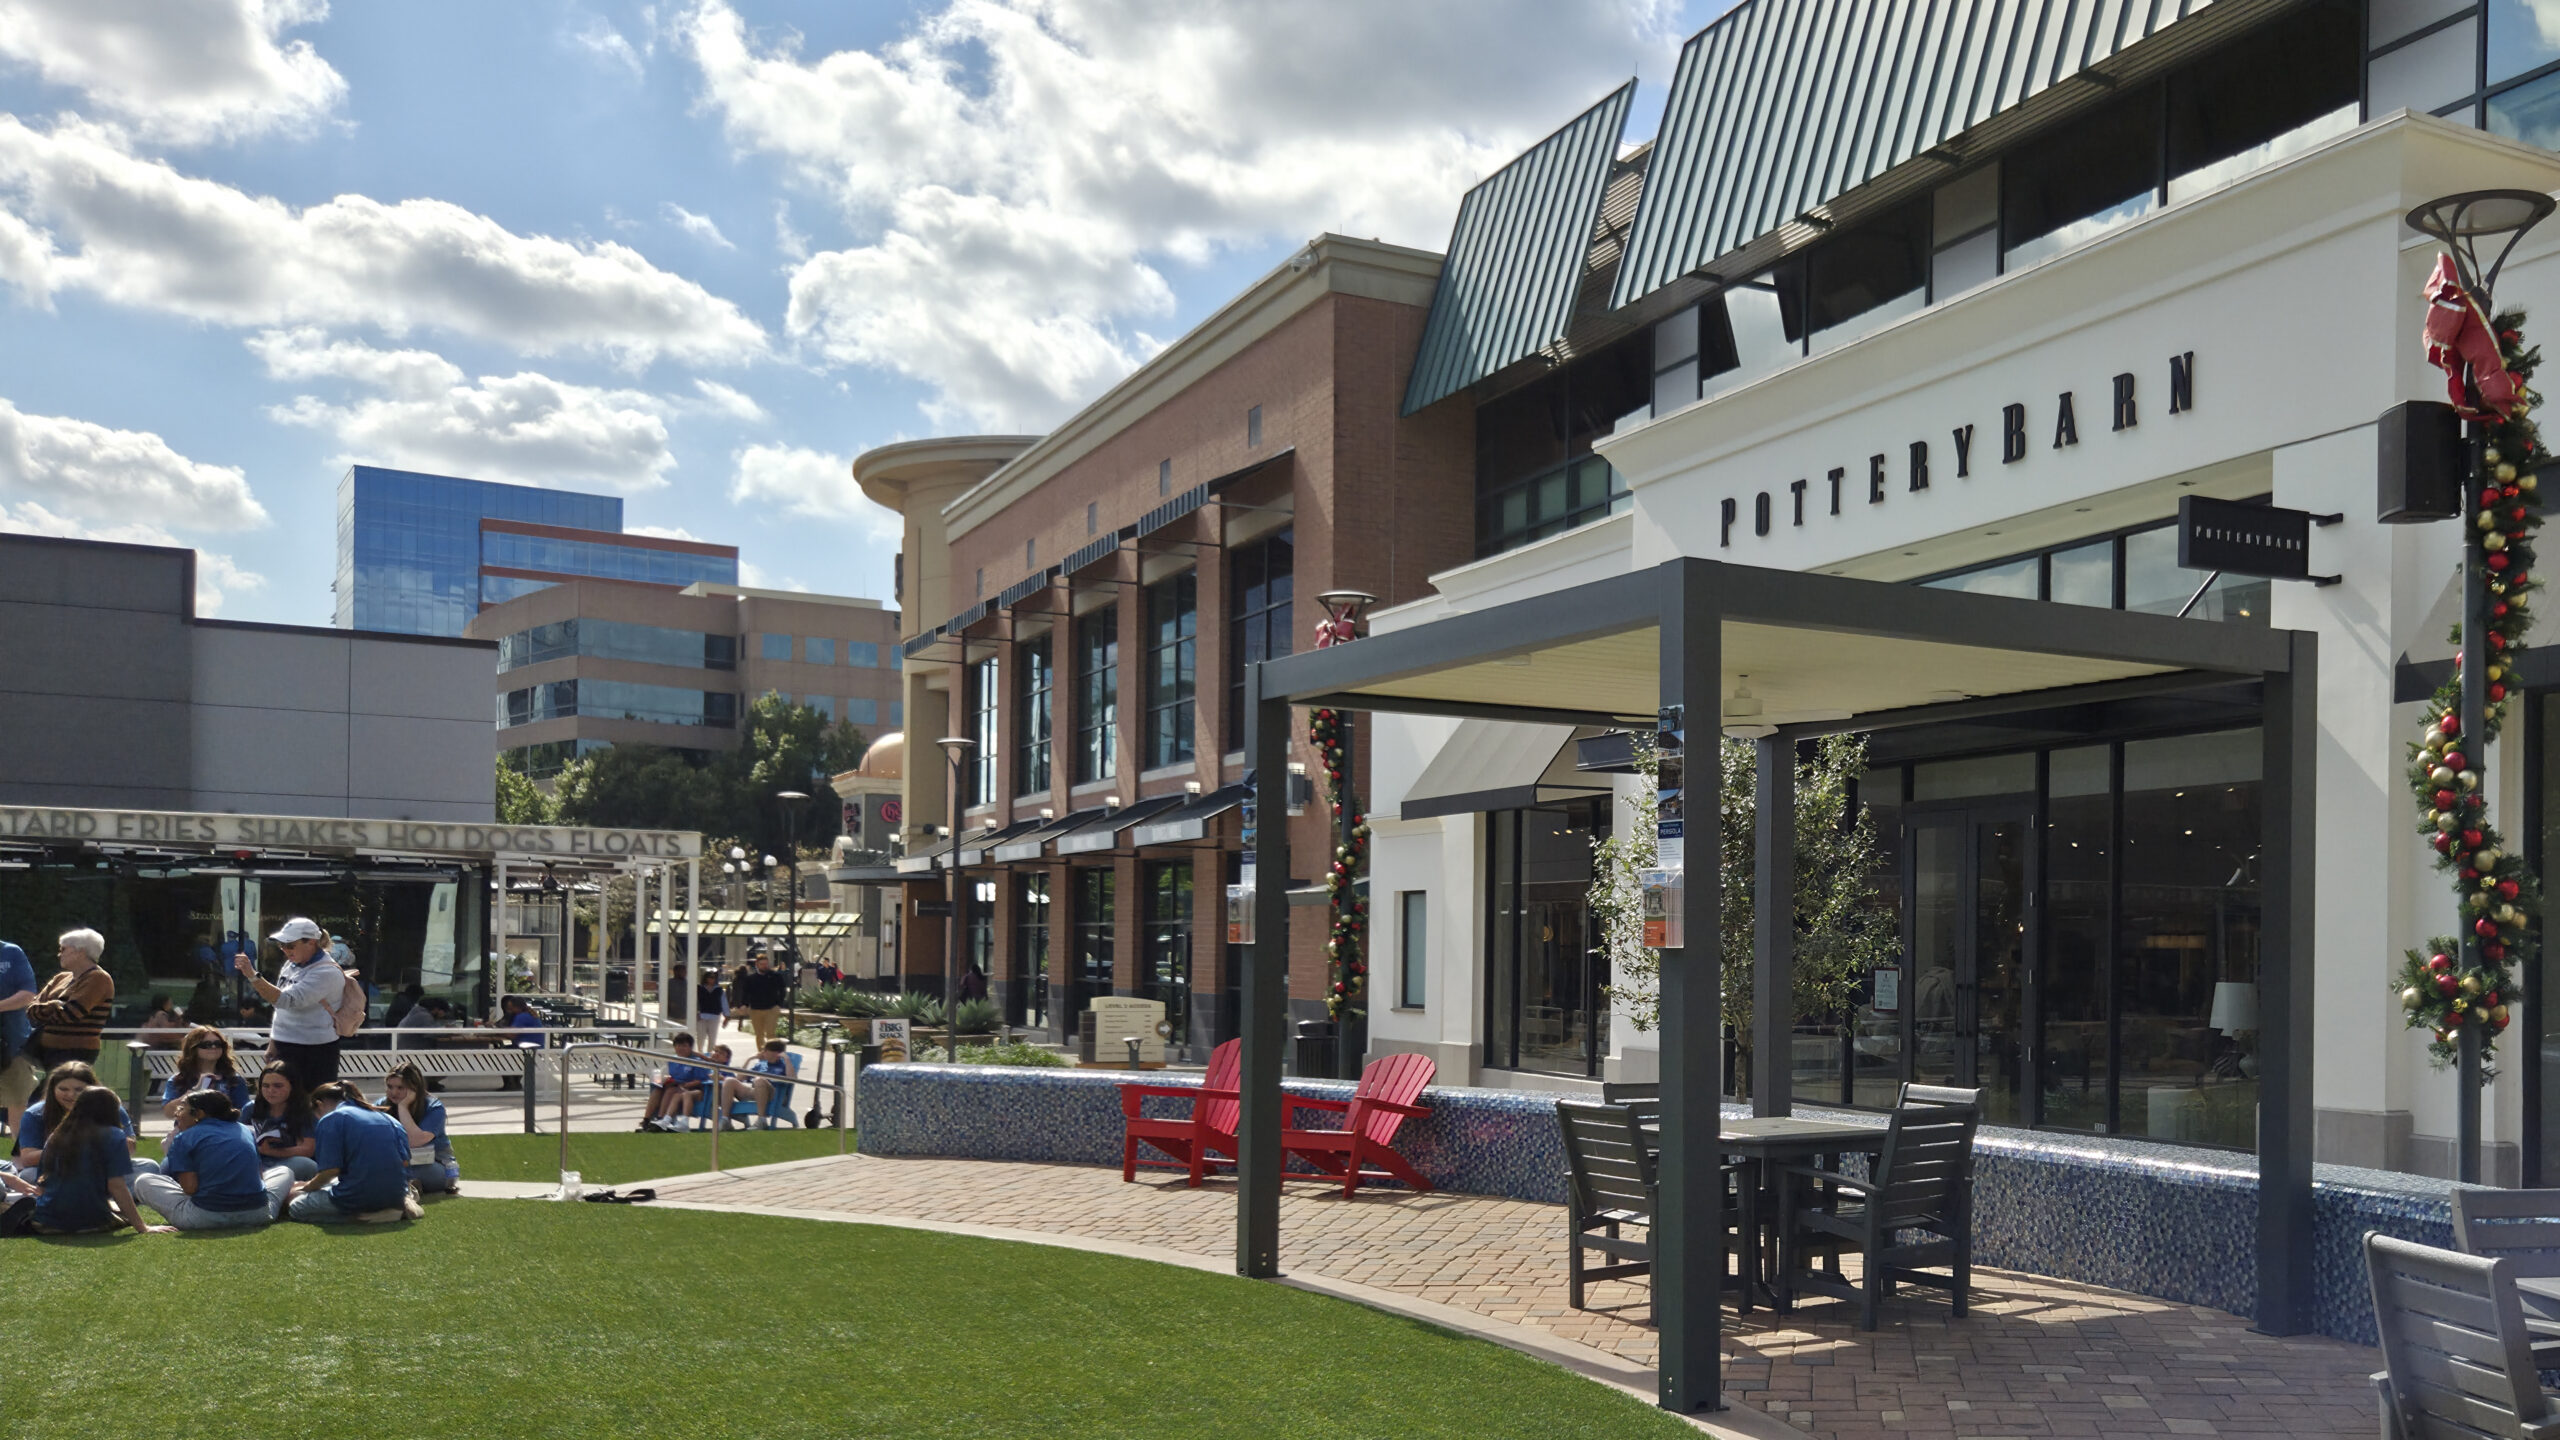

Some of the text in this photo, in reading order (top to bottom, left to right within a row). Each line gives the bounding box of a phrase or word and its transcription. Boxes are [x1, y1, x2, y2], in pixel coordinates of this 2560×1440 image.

[0, 808, 681, 856] TARD FRIES SHAKES HOT DOGS FLOATS
